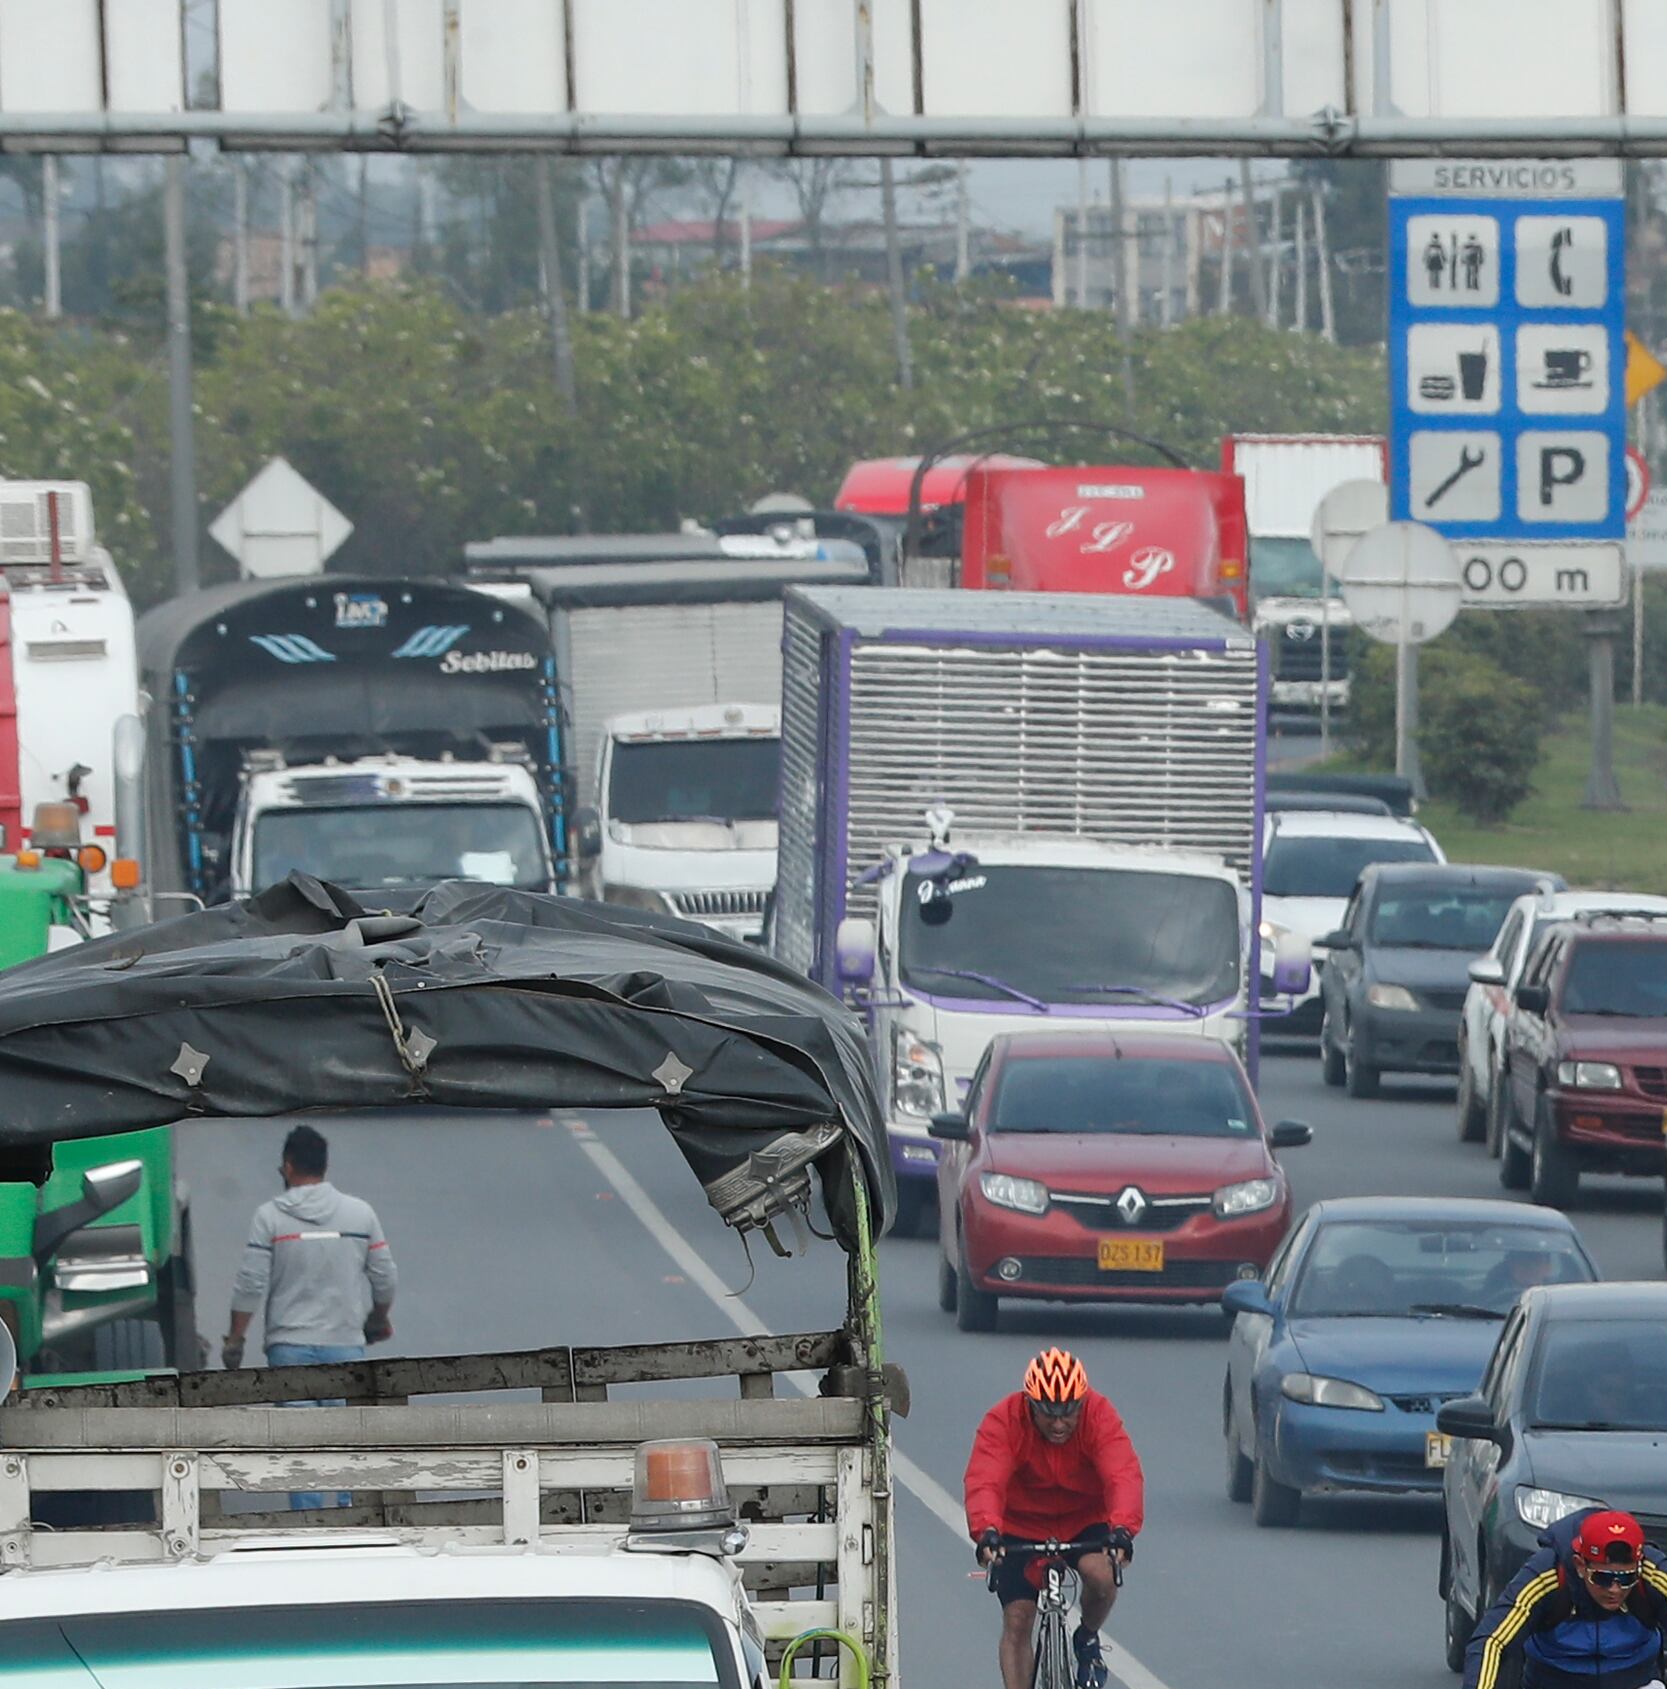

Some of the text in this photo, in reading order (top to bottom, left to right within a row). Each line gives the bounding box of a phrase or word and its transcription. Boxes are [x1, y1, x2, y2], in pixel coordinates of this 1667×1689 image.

[1435, 166, 1576, 189] SERVICIOS
[1540, 446, 1585, 505] P
[1463, 556, 1589, 592] 00 m
